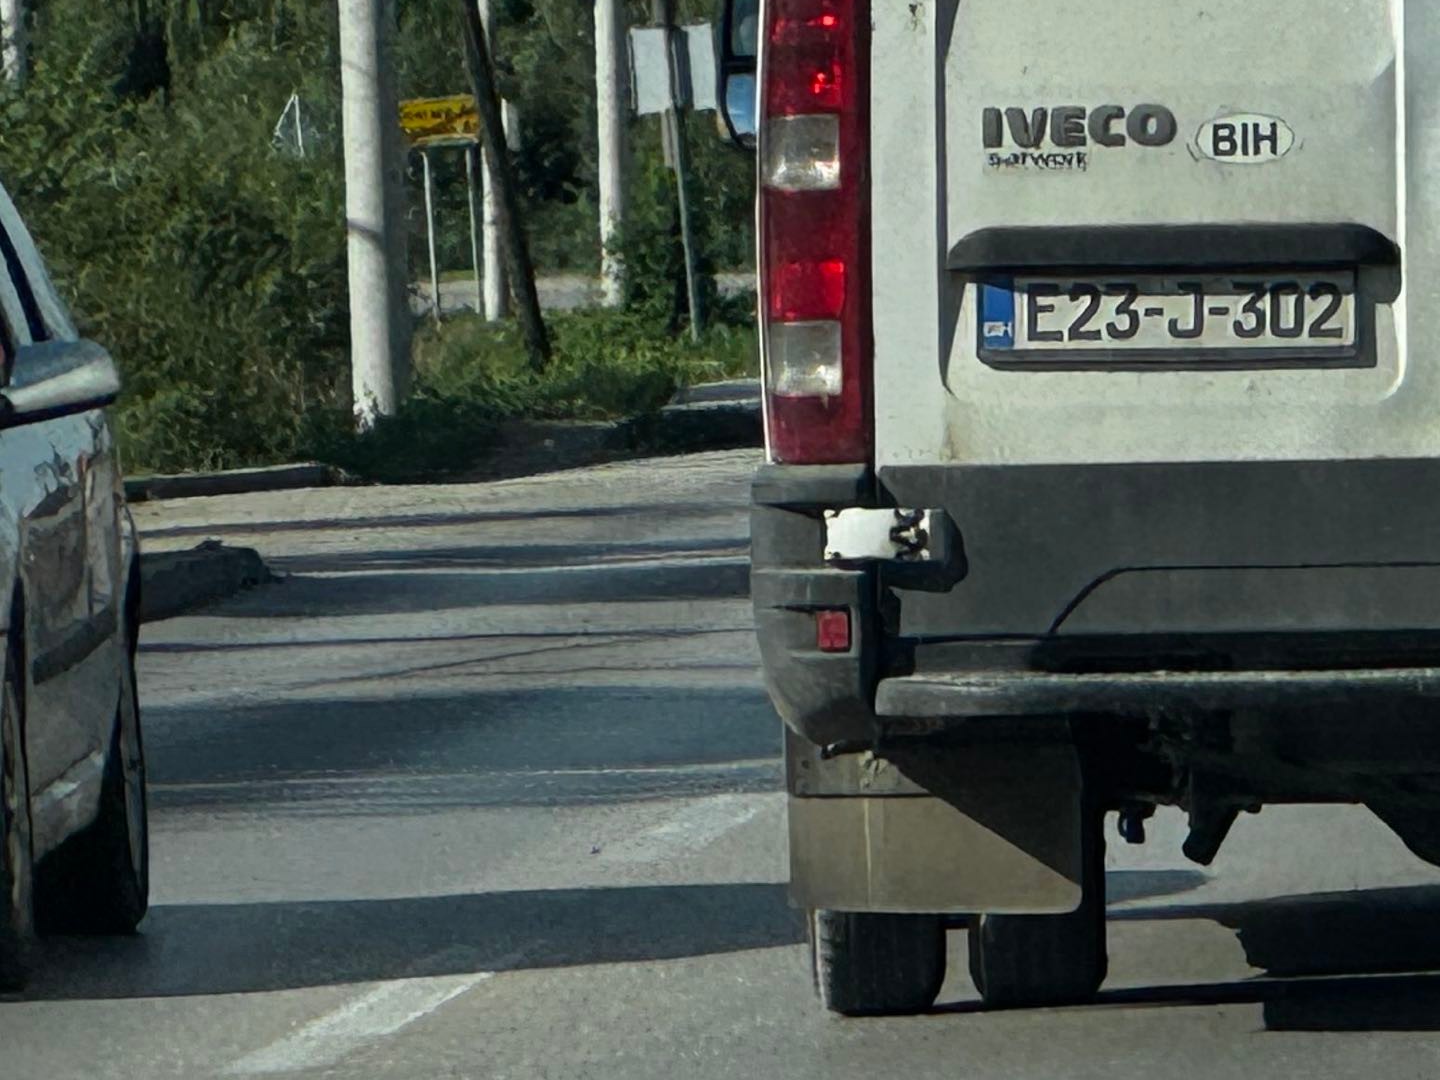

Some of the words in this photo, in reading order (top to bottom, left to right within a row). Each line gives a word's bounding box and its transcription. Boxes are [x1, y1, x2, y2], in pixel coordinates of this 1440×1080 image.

[983, 104, 1178, 149] IVECO
[1212, 122, 1278, 157] BIH
[1027, 282, 1344, 342] E23-J-302
